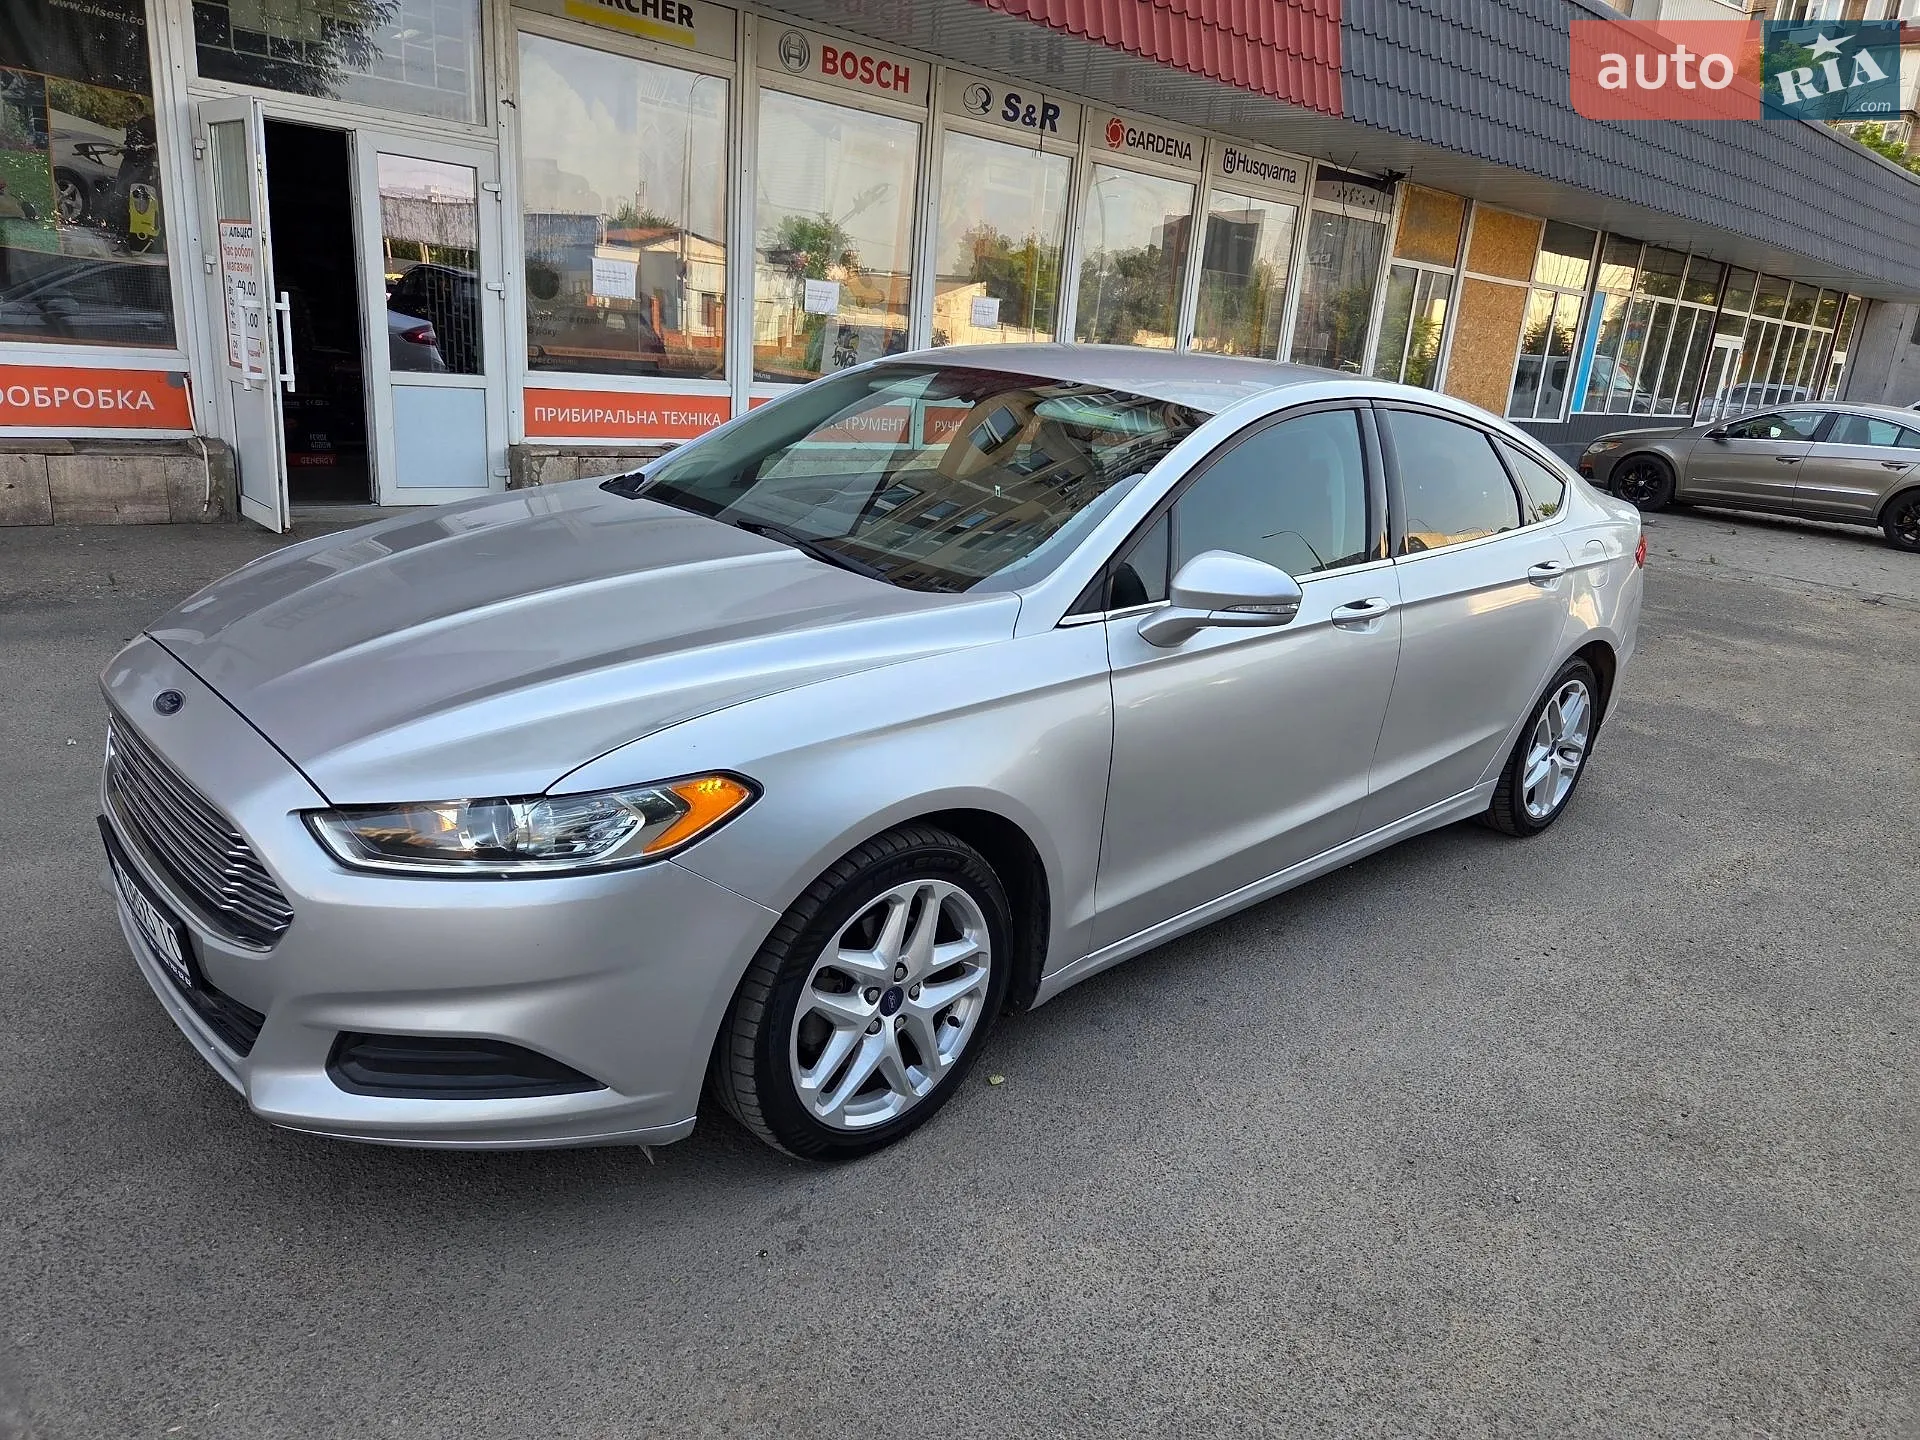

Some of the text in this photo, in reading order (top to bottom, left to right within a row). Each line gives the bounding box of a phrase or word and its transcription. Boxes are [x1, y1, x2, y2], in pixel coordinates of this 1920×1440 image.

[821, 45, 910, 94] BOSCH
[1001, 92, 1060, 133] S&R
[1126, 127, 1192, 161] GARDENA
[1236, 151, 1297, 185] Husqvarna
[0, 385, 155, 411] ОБРОБКА
[534, 407, 721, 426] ПРИБИРАЛЬНА ТЕХНІКА
